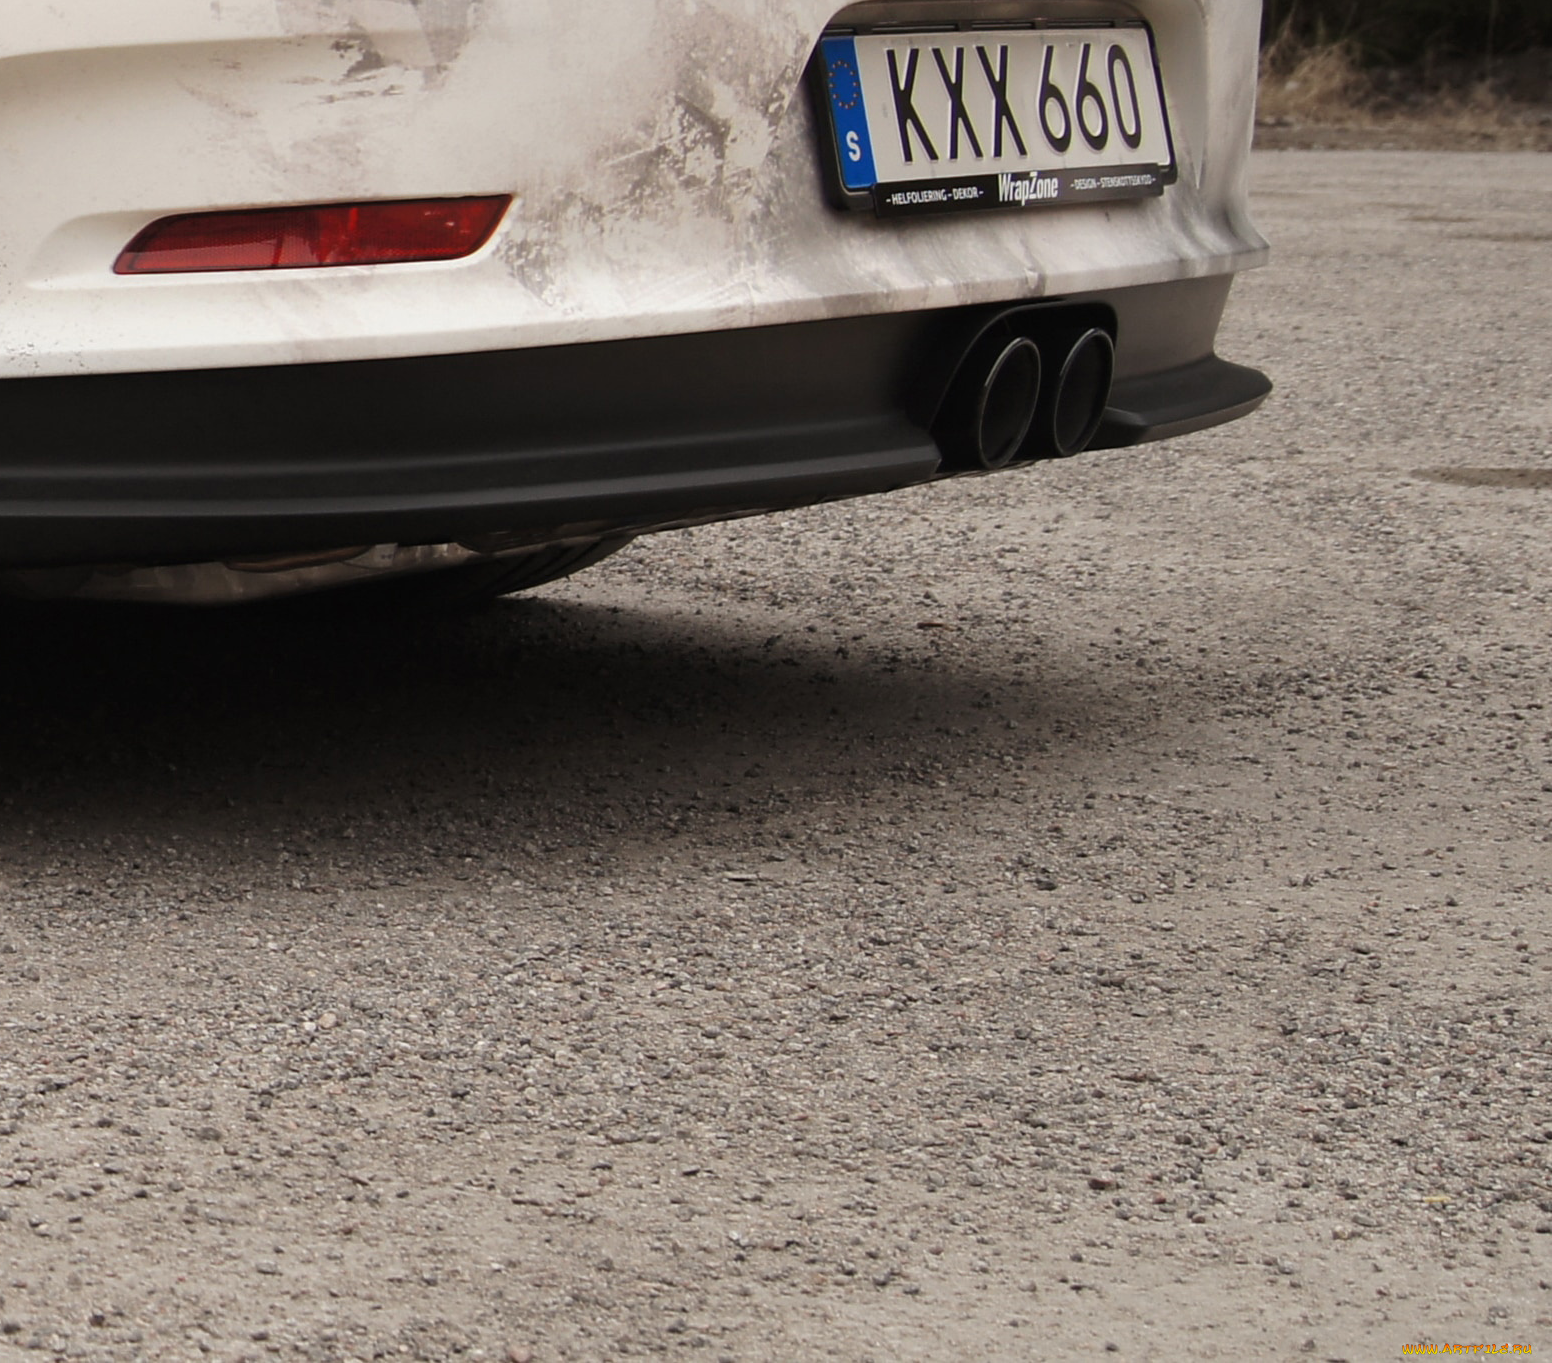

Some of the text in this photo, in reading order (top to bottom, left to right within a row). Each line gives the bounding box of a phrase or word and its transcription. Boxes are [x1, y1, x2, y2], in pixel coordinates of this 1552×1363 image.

[886, 43, 1142, 164] KXX 660
[846, 130, 862, 163] S
[891, 186, 979, 205] HELFOLIERING DEKOR
[998, 171, 1059, 206] WrapZone
